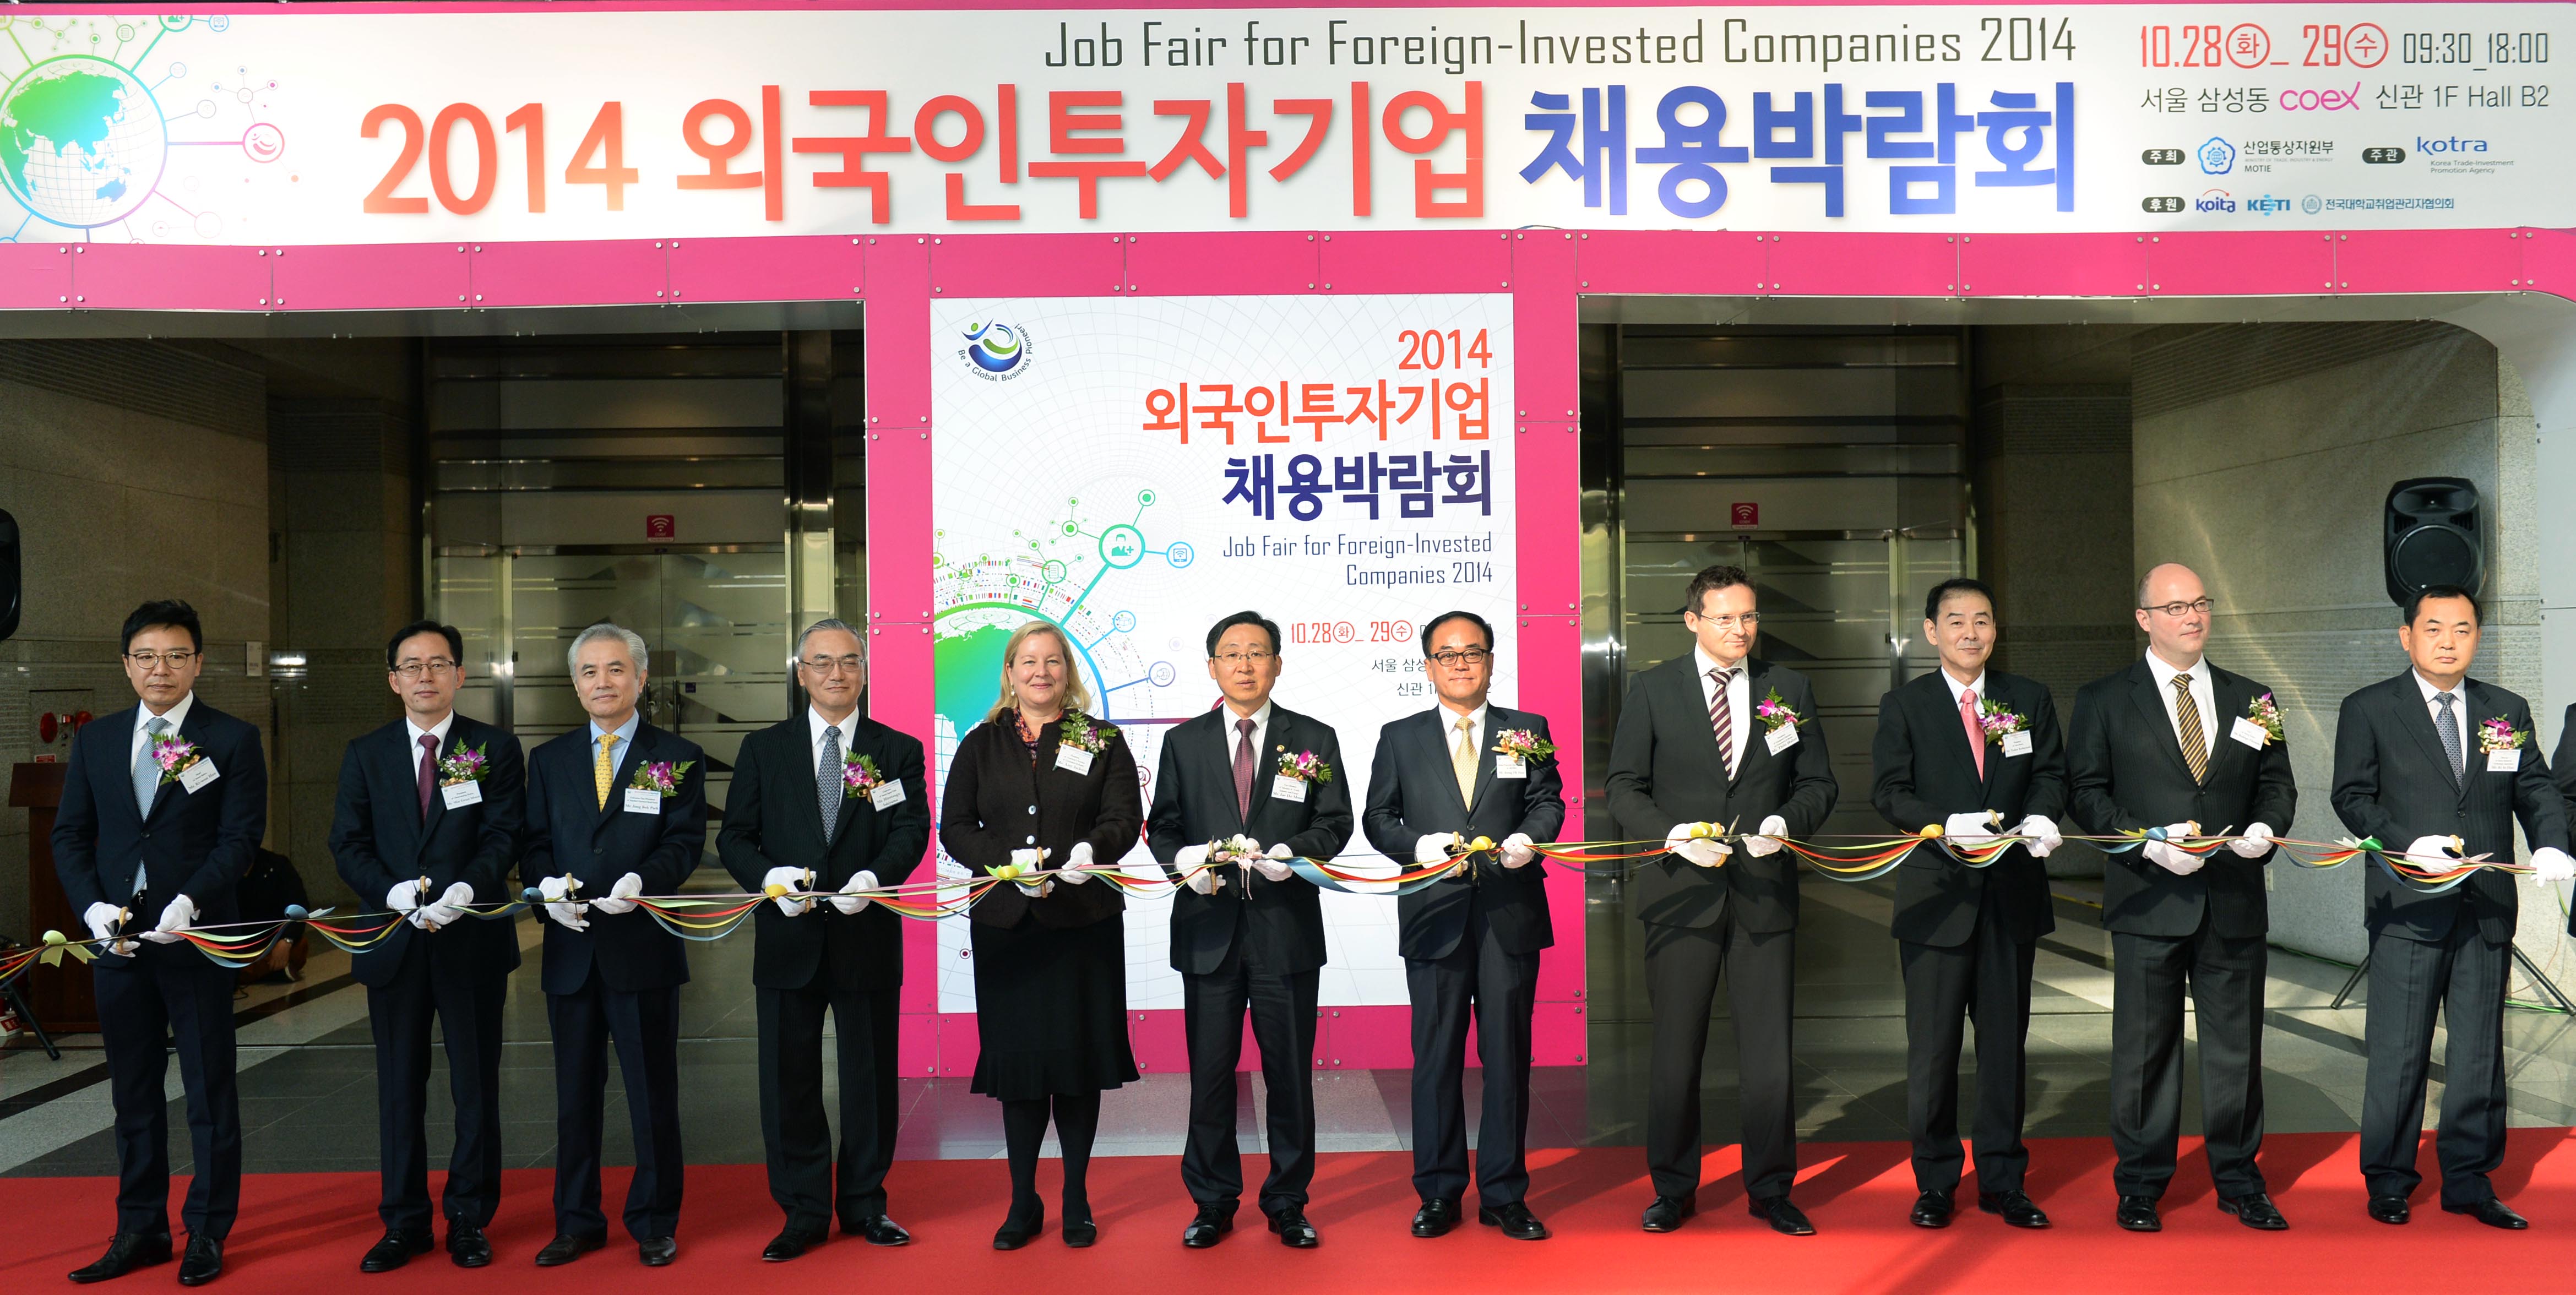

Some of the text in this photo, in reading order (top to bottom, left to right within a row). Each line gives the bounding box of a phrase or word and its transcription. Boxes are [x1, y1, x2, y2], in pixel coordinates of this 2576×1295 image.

[1046, 17, 2076, 74] Job Fair for Foreign-Invested Companies 2014
[2141, 81, 2548, 113] 서울 삼성동 coex 신관 1F Hall B2
[361, 81, 2075, 224] 2014 외국인투자기업 채용박람회
[2149, 150, 2177, 164] 주최
[2244, 140, 2333, 155] 산업통상자원부
[2370, 149, 2398, 162] 주관
[2417, 137, 2487, 155] kotra
[2150, 198, 2177, 211] 후원
[2196, 195, 2236, 213] koita
[2326, 198, 2454, 210] 전국대학교취업관리자협의회
[1398, 329, 1492, 370] 2014
[958, 350, 966, 360] Be
[972, 367, 997, 382] Global
[1001, 358, 1031, 381] Business
[1143, 377, 1489, 445] 외국인투자기업
[1222, 450, 1491, 521] 채용박람회
[1224, 531, 1491, 558] Job Fair for Foreign-Invested
[1347, 562, 1492, 589] Companies 2014
[1372, 659, 1397, 672] 서울
[1397, 683, 1422, 696] 신관
